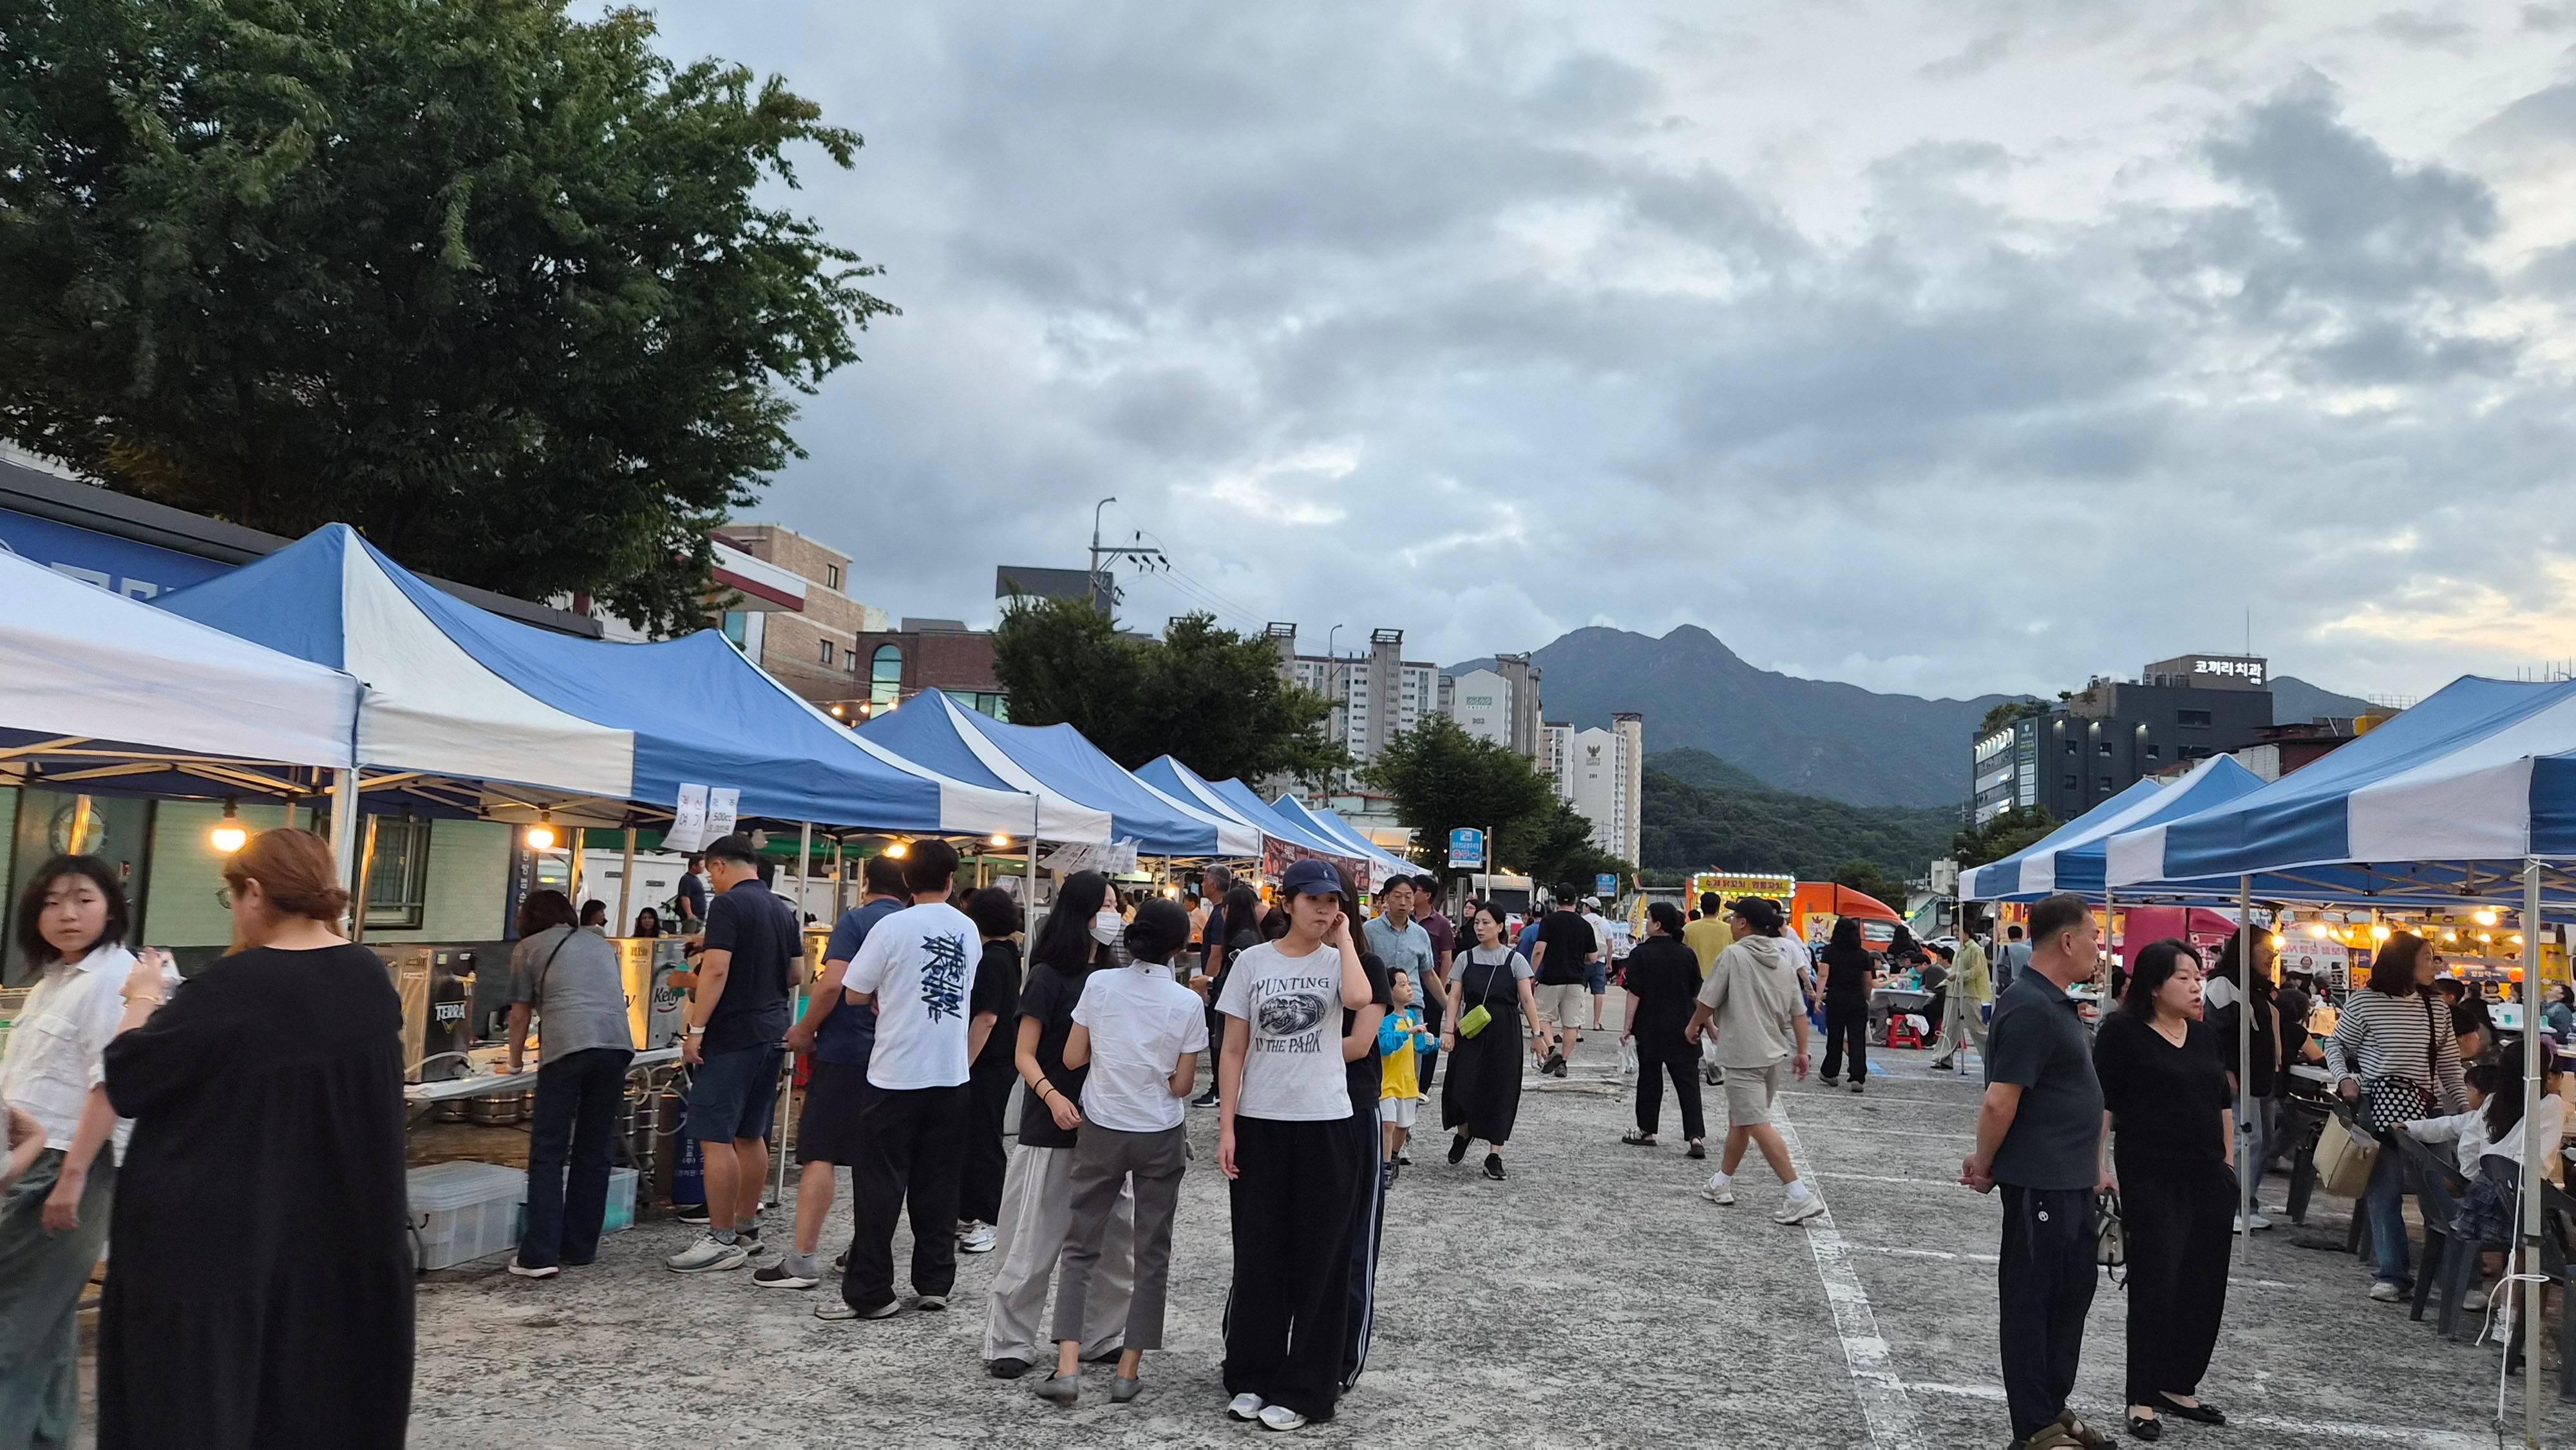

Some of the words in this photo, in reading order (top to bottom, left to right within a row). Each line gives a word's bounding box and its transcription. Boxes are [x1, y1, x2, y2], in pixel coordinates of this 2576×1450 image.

[2193, 660, 2234, 677] 코끼리
[2235, 662, 2263, 678] 치과
[435, 1004, 466, 1021] TERRA
[1265, 1039, 1287, 1053] THE
[1288, 1029, 1323, 1054] PARK
